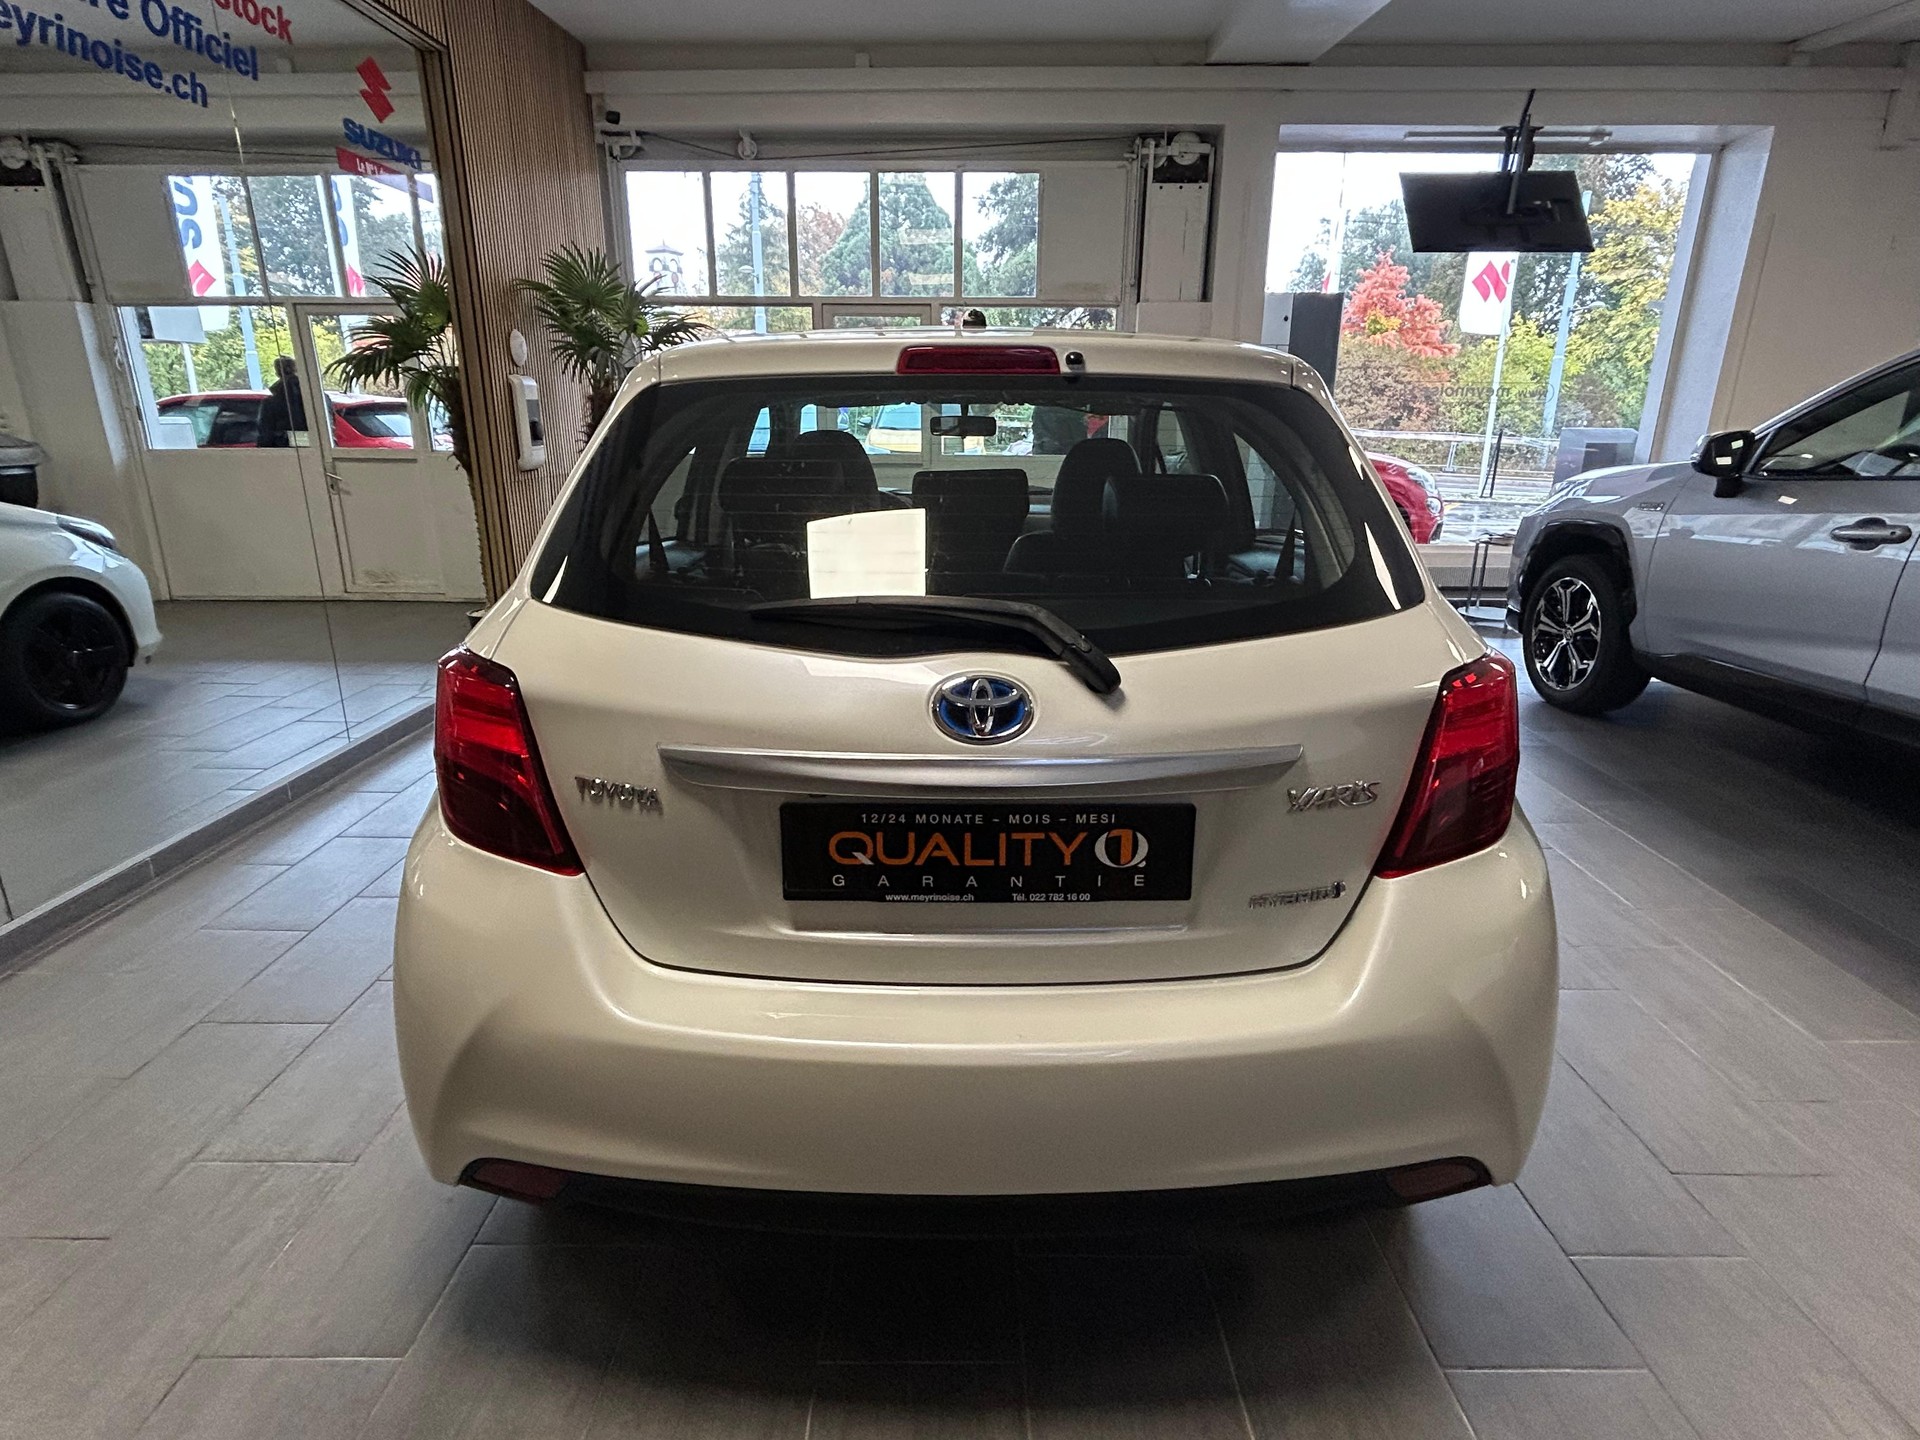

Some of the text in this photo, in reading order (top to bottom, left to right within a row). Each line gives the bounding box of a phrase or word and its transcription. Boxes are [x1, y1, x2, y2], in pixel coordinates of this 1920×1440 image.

[140, 0, 259, 81] Officiel
[342, 117, 422, 171] SUZUKI
[574, 775, 664, 814] TOYOTA
[1287, 780, 1381, 812] YARIS
[861, 813, 907, 824] 12/24
[915, 813, 984, 824] MONATE
[1008, 813, 1051, 824] MOIS
[1075, 813, 1116, 824] MESI
[828, 831, 1088, 867] QUALITY
[832, 874, 1145, 887] GARANTIE
[885, 892, 1091, 903] www.meyrinoise.ch Tél. 022 782 16 00
